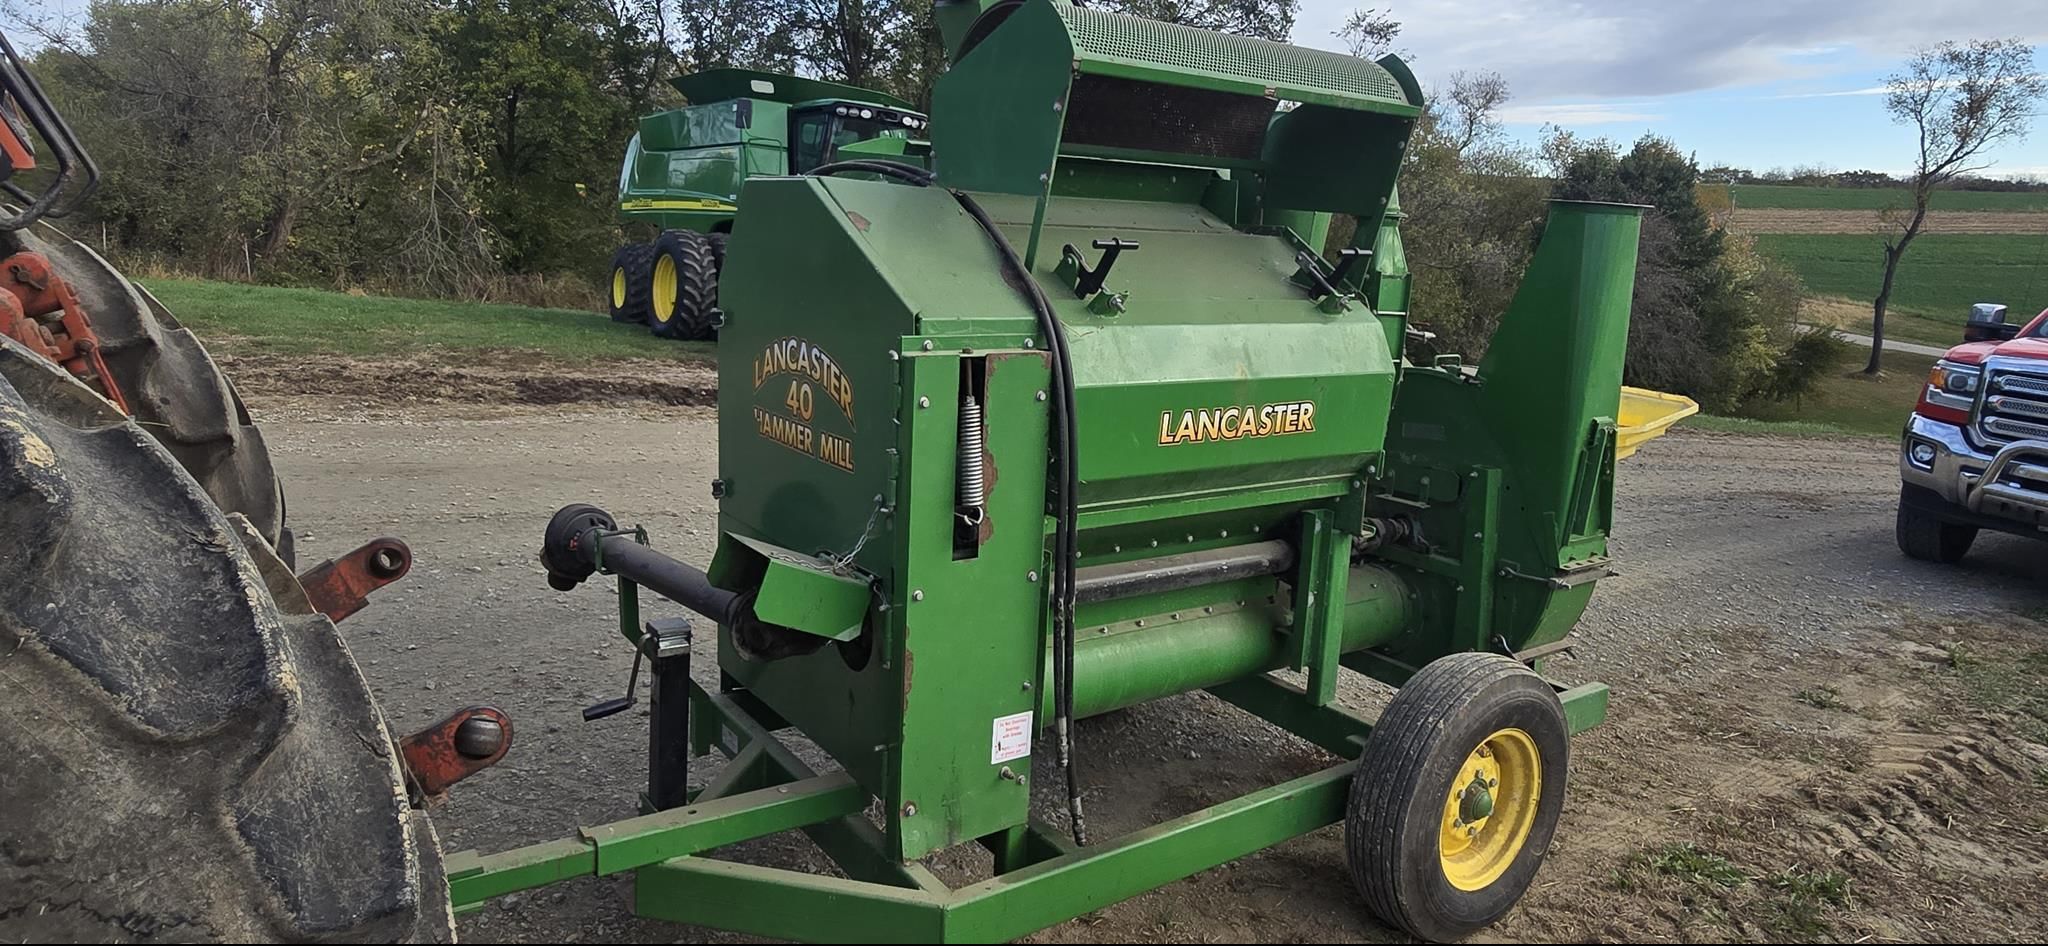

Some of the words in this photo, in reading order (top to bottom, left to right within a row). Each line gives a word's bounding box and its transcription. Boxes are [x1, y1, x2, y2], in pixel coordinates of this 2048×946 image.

[754, 338, 854, 424] LANCASTER
[786, 379, 813, 421] 40
[753, 407, 814, 454] HAMMER
[820, 432, 854, 470] MILL
[1159, 402, 1315, 443] LANCASTER
